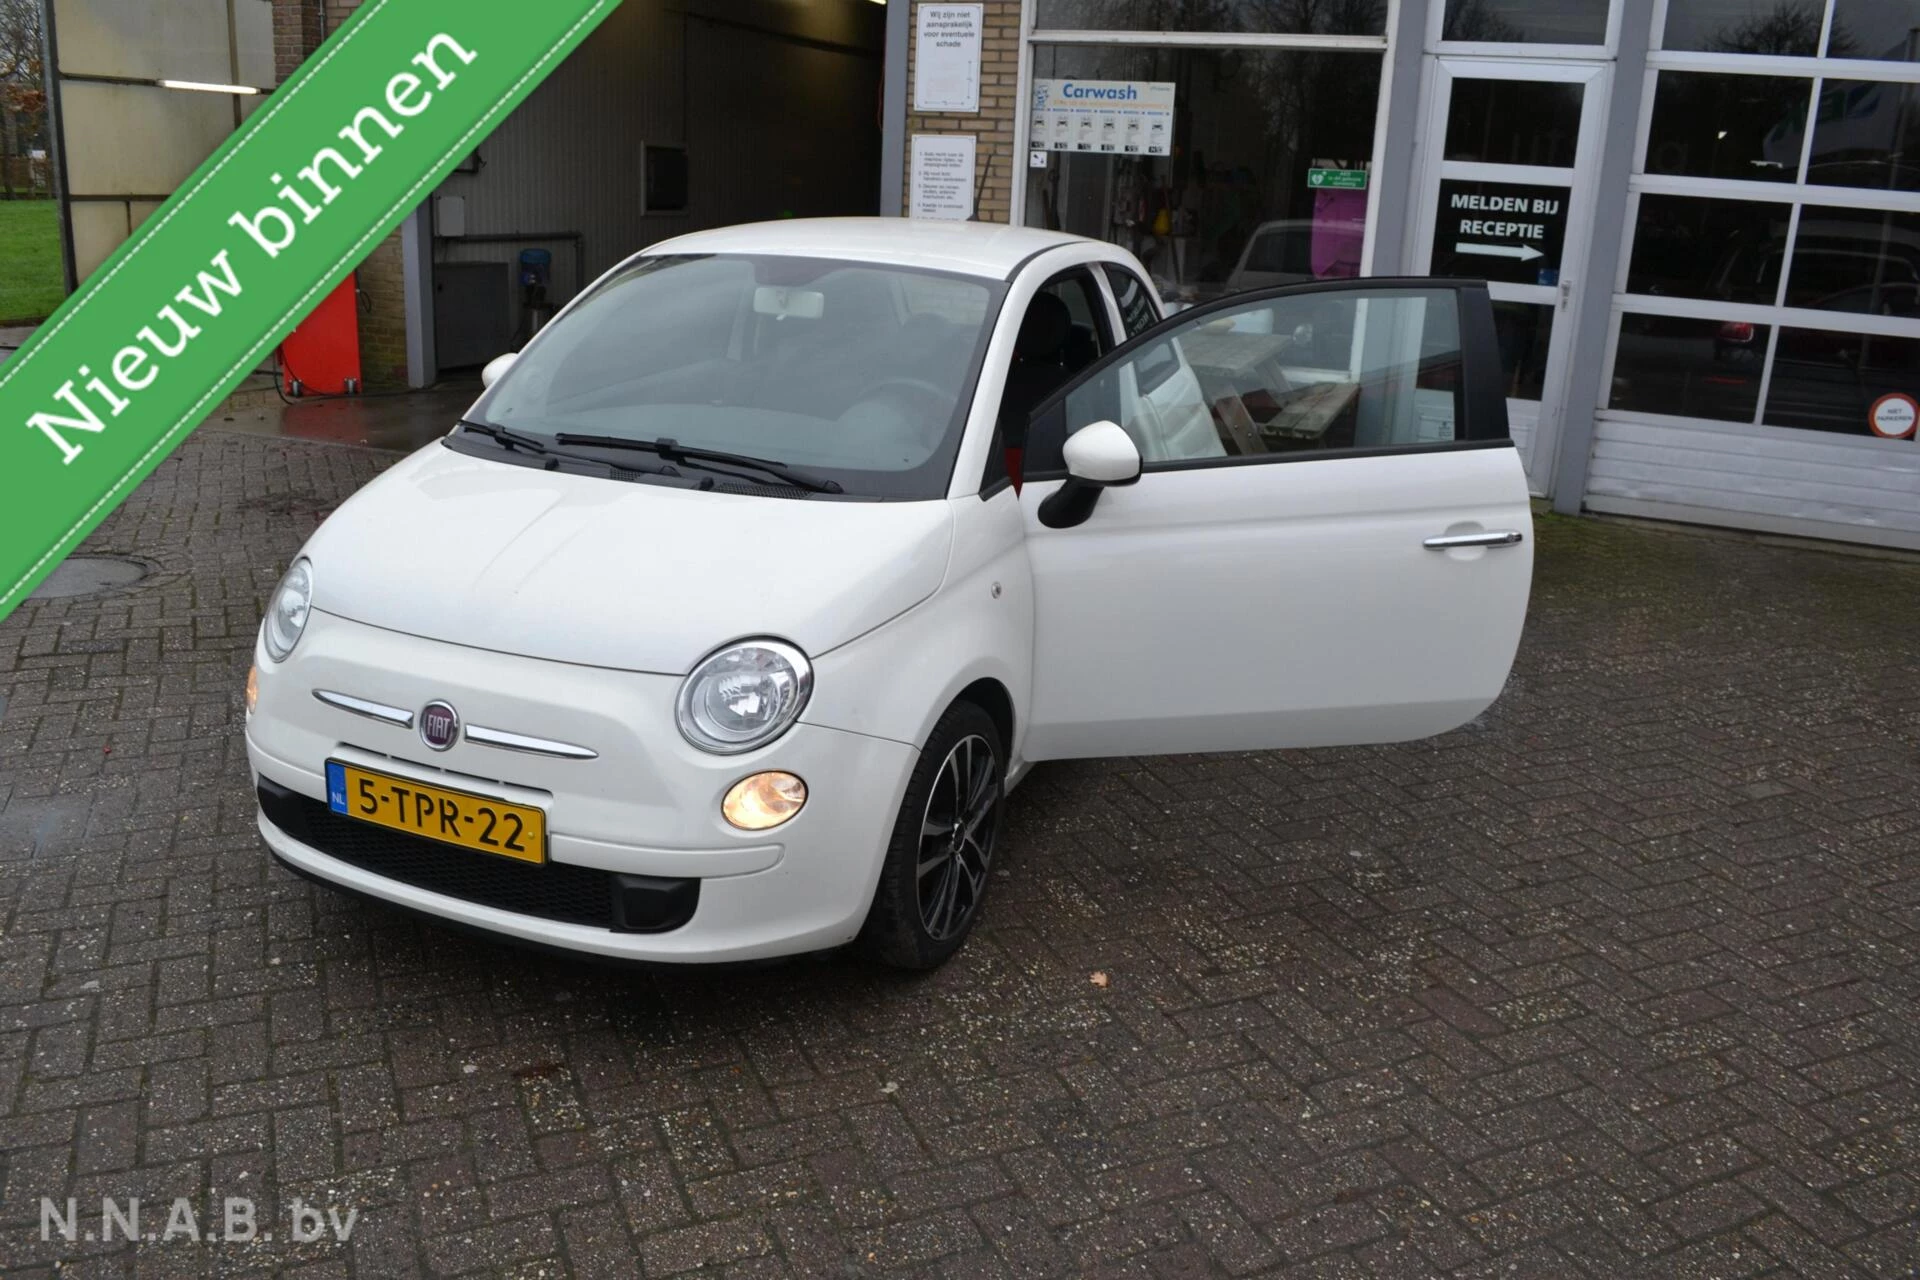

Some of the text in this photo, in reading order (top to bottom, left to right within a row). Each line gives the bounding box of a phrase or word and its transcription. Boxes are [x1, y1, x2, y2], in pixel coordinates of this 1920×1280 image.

[930, 11, 941, 19] Wij
[926, 21, 972, 29] aansprakelijk
[1063, 83, 1137, 100] Carwash
[1451, 194, 1559, 215] MELDEN BIJ
[1460, 219, 1545, 239] RECEPTIE
[427, 714, 451, 739] FIAT
[331, 792, 345, 806] NL
[359, 778, 525, 852] 5-TPR-22
